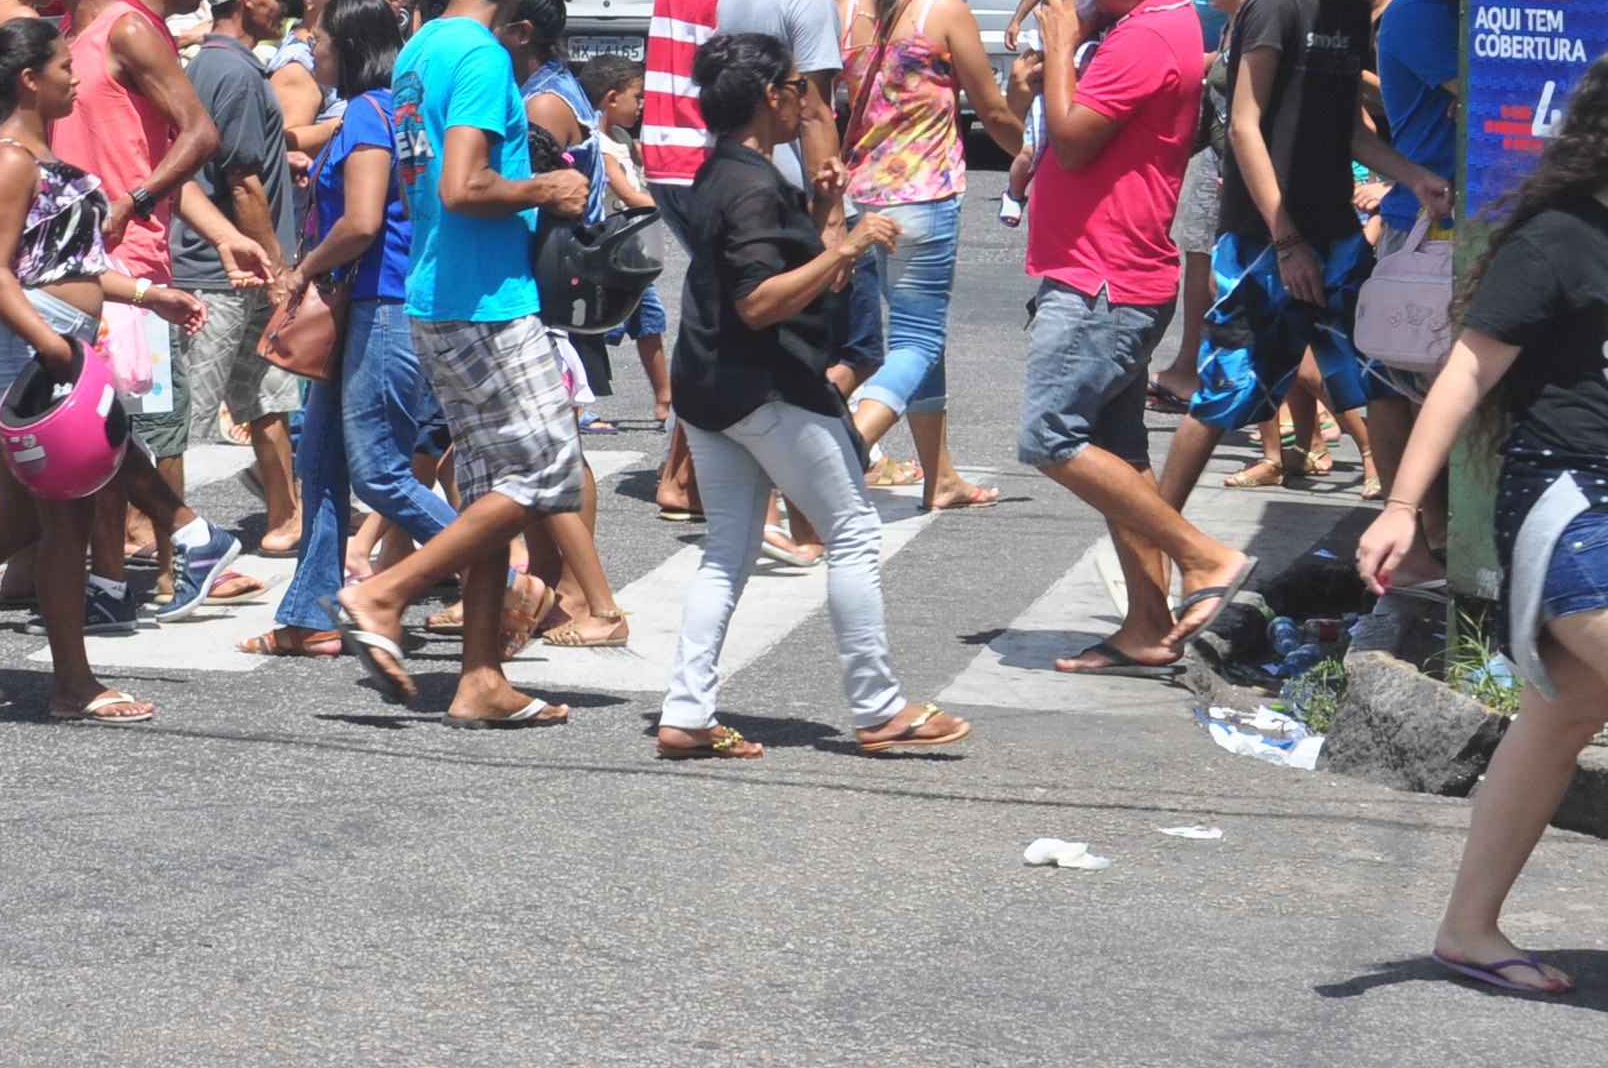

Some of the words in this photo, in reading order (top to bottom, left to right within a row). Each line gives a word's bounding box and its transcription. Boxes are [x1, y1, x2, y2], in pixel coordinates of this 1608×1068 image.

[1474, 6, 1522, 35] AQUI
[1524, 8, 1564, 33] TEM
[1474, 33, 1587, 63] COBERTURA
